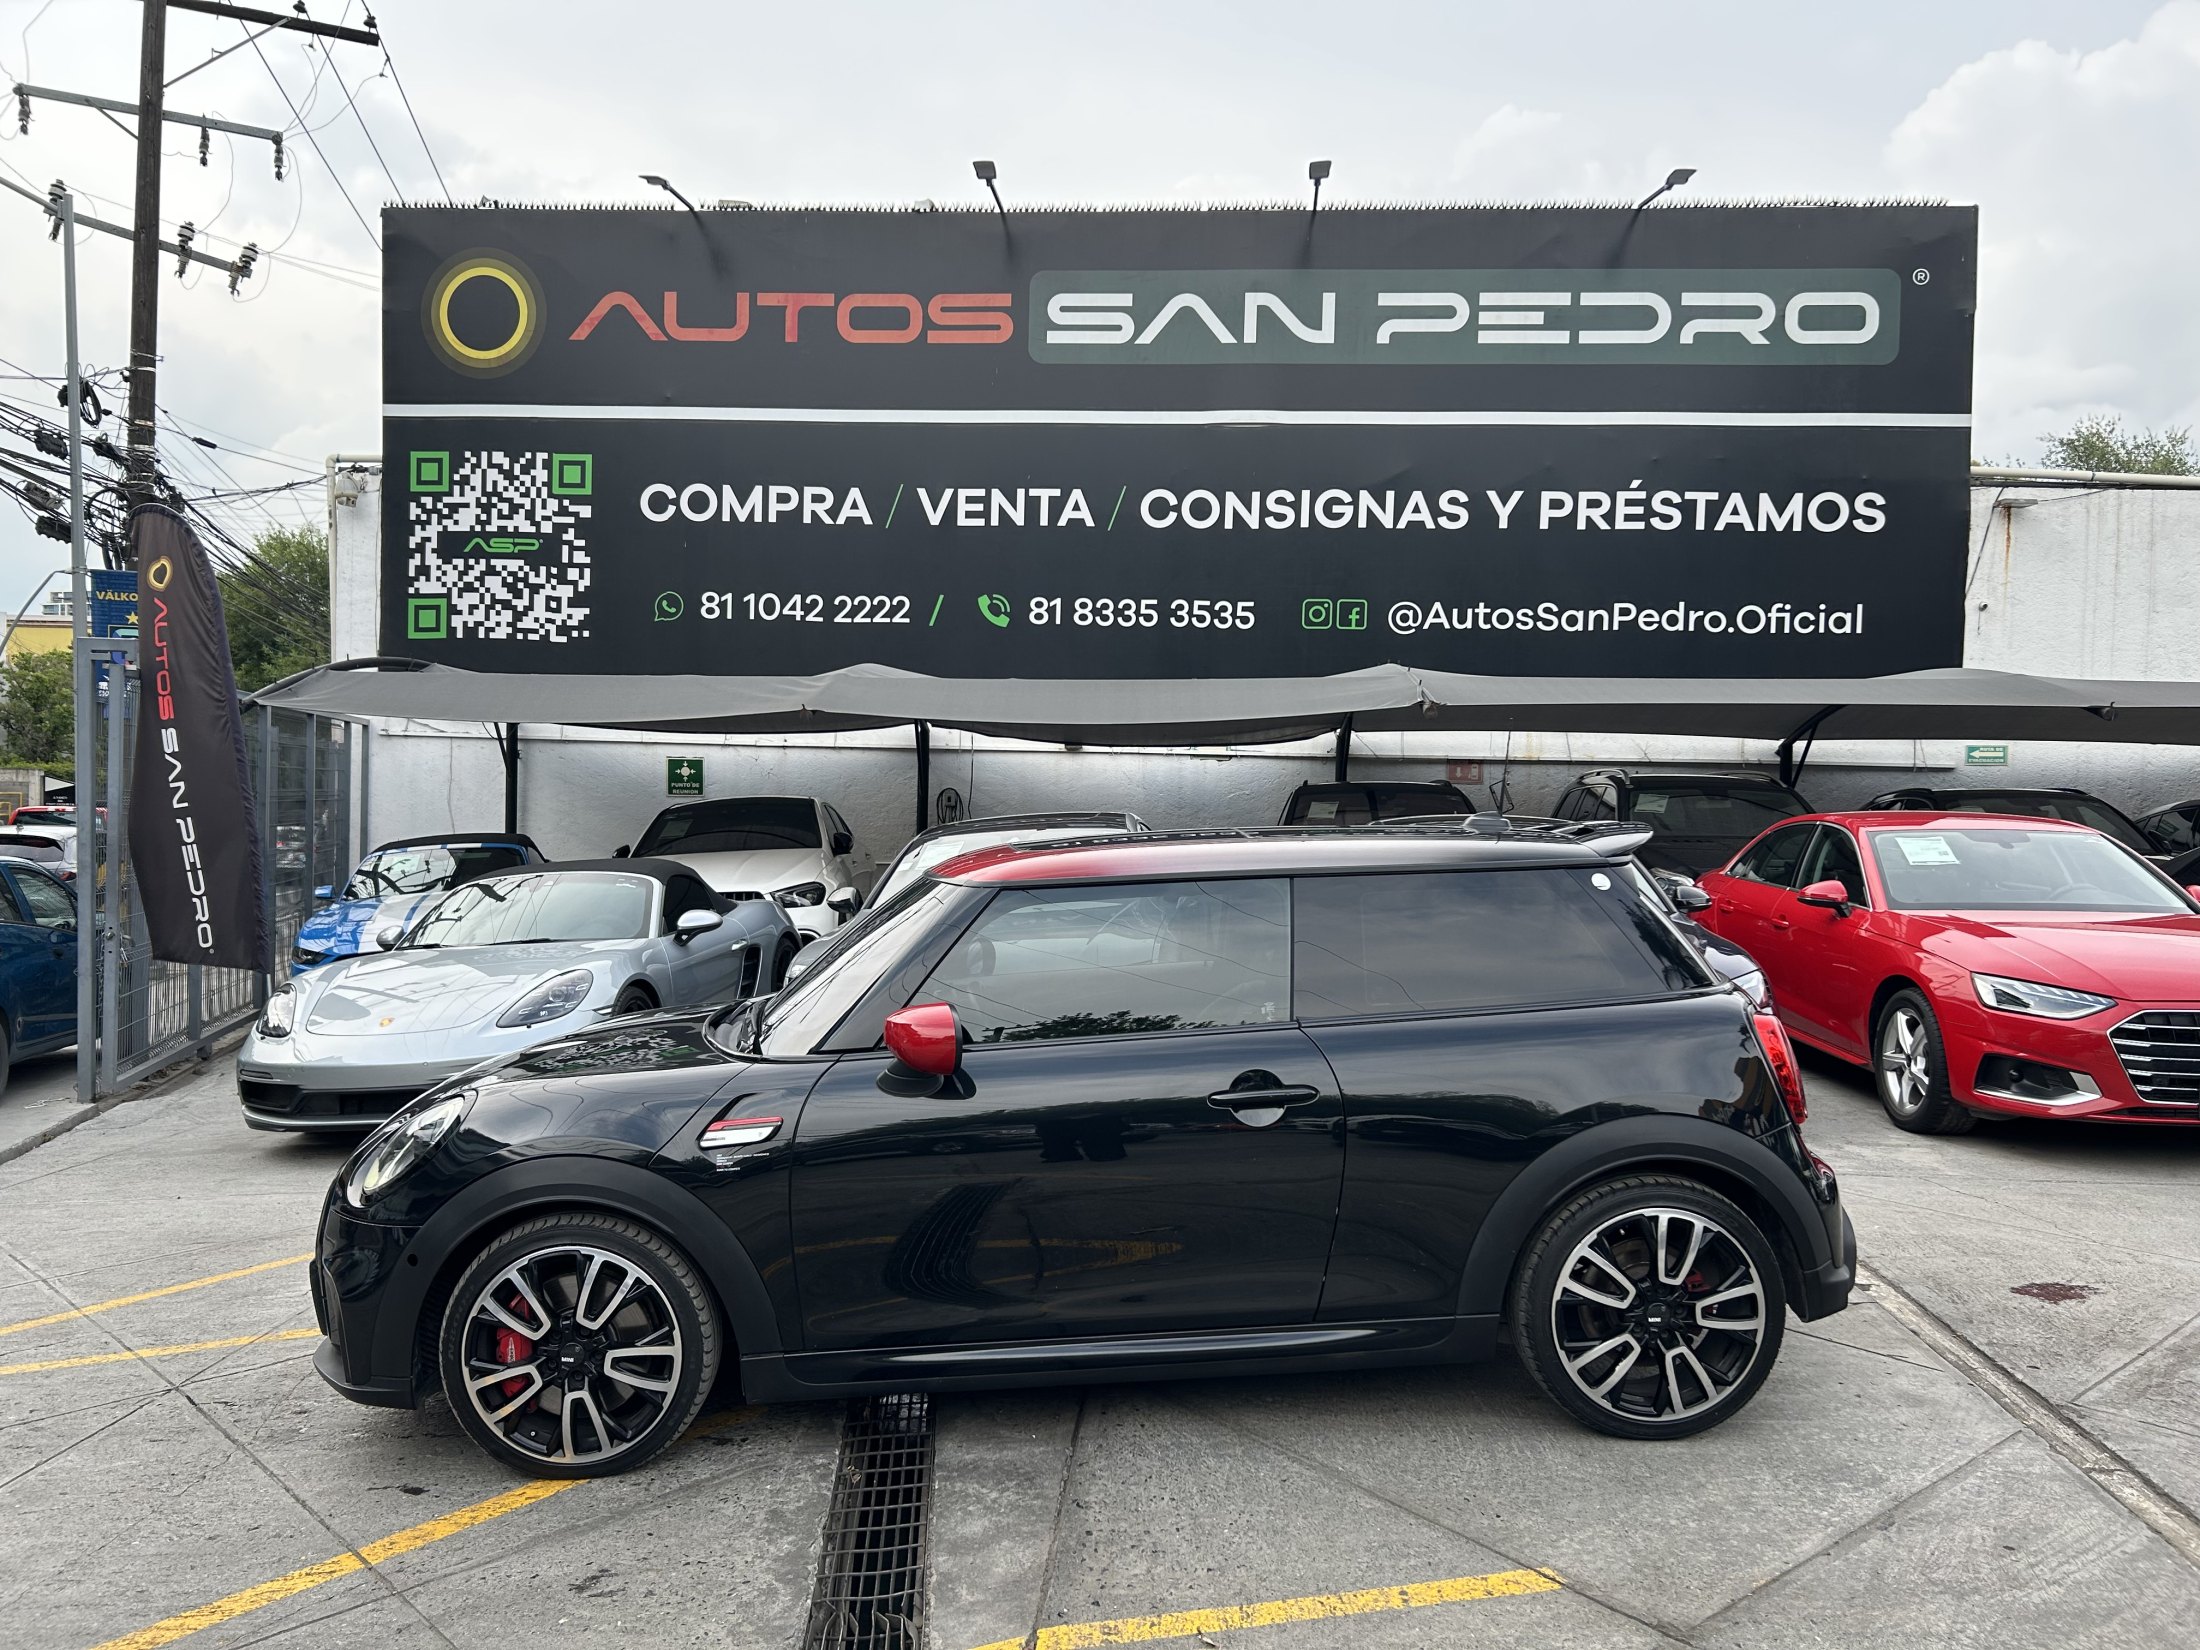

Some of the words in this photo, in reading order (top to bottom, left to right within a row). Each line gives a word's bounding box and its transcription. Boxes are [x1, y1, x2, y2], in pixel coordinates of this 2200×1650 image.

[569, 291, 1014, 344] AUTOS
[1046, 292, 1337, 345] SAN
[1376, 291, 1880, 345] PEDRO
[639, 483, 875, 526] COMPRA
[916, 487, 1096, 528] VENTA
[1140, 488, 1470, 531] CONSIGNAS
[1485, 490, 1525, 530] Y
[1539, 479, 1887, 533] PRÉSTAMOS
[700, 591, 733, 620] 81
[743, 592, 824, 622] 1042
[833, 595, 911, 624] 2222
[1028, 596, 1062, 626] 81
[1073, 597, 1159, 628] 8335
[1169, 598, 1255, 630] 3535
[1387, 601, 1864, 636] @AutosSanPedro.Oficial
[153, 597, 175, 721] AUTOS
[161, 727, 189, 809] SAN
[175, 816, 213, 949] PEDRO
